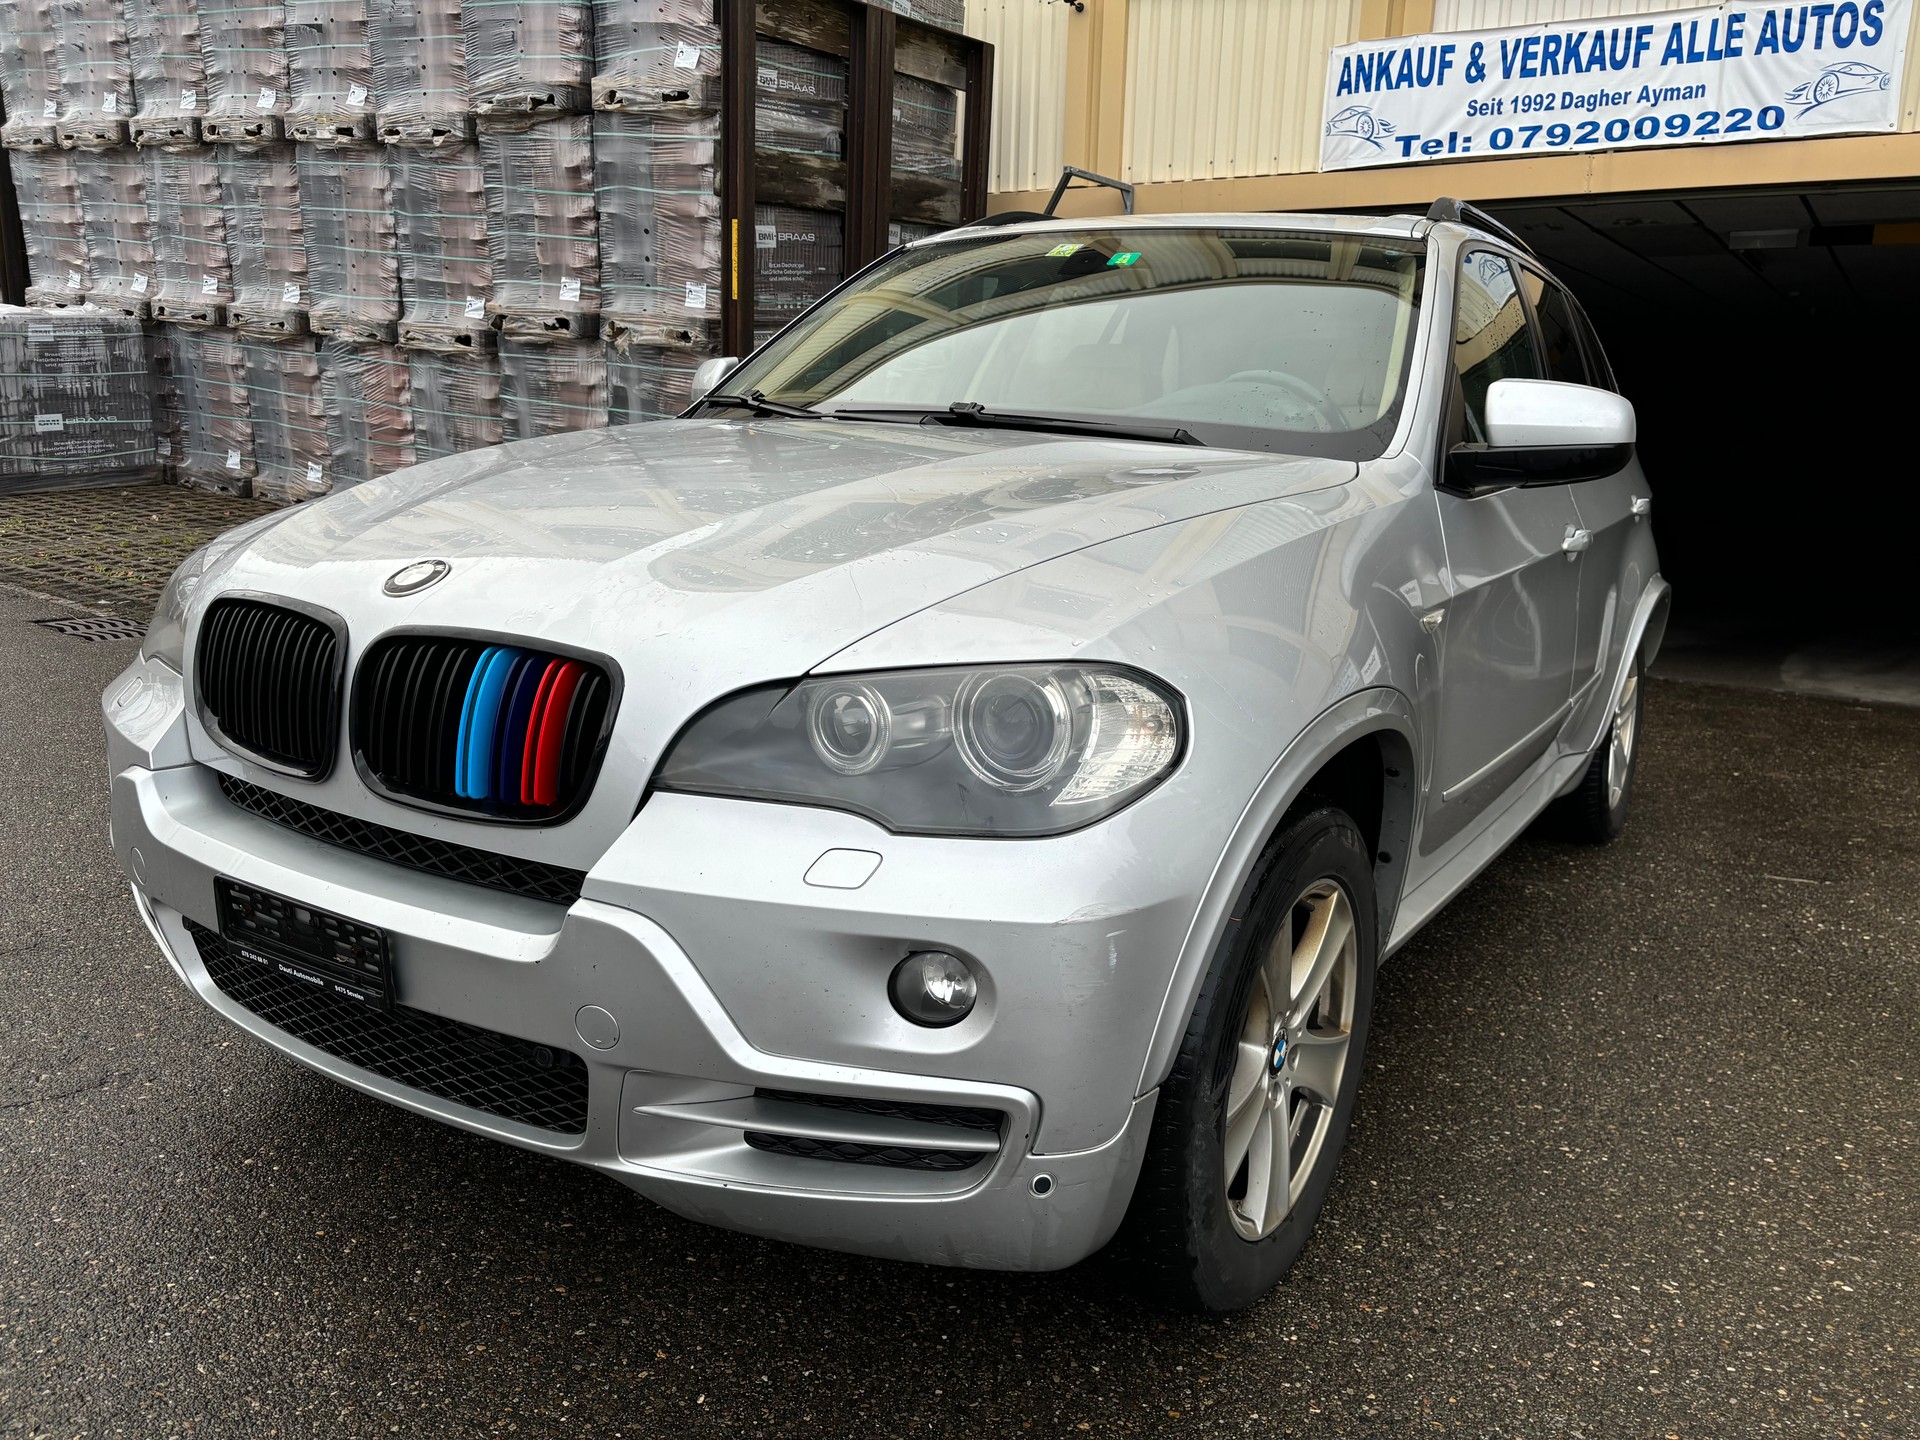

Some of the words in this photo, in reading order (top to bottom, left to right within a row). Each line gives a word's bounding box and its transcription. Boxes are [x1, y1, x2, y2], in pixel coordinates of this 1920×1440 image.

[1336, 44, 1456, 97] ANKAUF
[1464, 41, 1487, 84] &
[1500, 25, 1654, 80] VERKAUF
[1660, 12, 1747, 66] ALLE
[1754, 0, 1885, 56] AUTOS
[779, 79, 816, 95] BRAAS
[1466, 98, 1504, 117] Seit
[1510, 92, 1556, 113] 1992
[1560, 89, 1632, 113] Dagher
[1636, 82, 1707, 107] Ayman
[1394, 131, 1473, 157] Tel:
[1489, 105, 1785, 151] 0792009220
[758, 232, 774, 241] BMI
[778, 232, 816, 242] BRAAS
